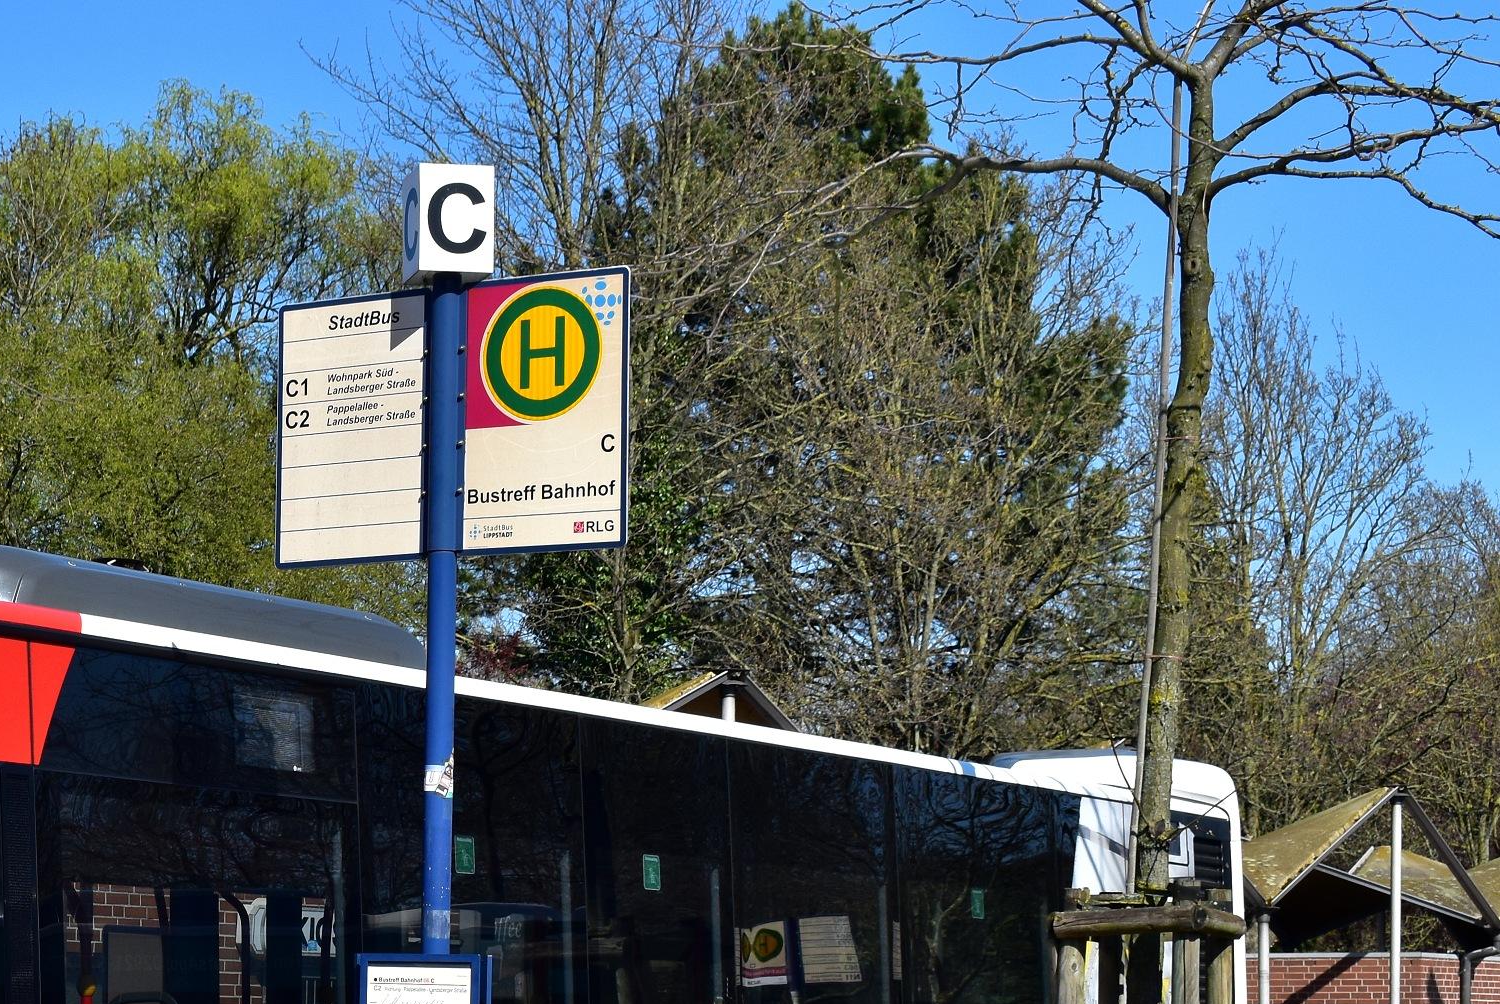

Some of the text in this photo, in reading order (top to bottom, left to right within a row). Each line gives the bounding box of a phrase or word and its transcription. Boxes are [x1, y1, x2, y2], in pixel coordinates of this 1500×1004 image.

[404, 187, 418, 262] C
[427, 182, 487, 254] C
[328, 310, 400, 330] StadtBus
[520, 315, 566, 390] H
[327, 370, 372, 383] Wohnpark
[375, 368, 394, 377] Süd
[285, 378, 308, 397] C1
[327, 379, 416, 396] Landsberger Straße
[327, 402, 378, 415] Pappelallee
[285, 409, 310, 429] C2
[326, 410, 416, 427] Landsberger Straße
[600, 434, 615, 453] C
[467, 480, 616, 504] Bustreff Bahnhof
[483, 531, 513, 539] LIPPSTADT
[586, 520, 614, 533] RLG
